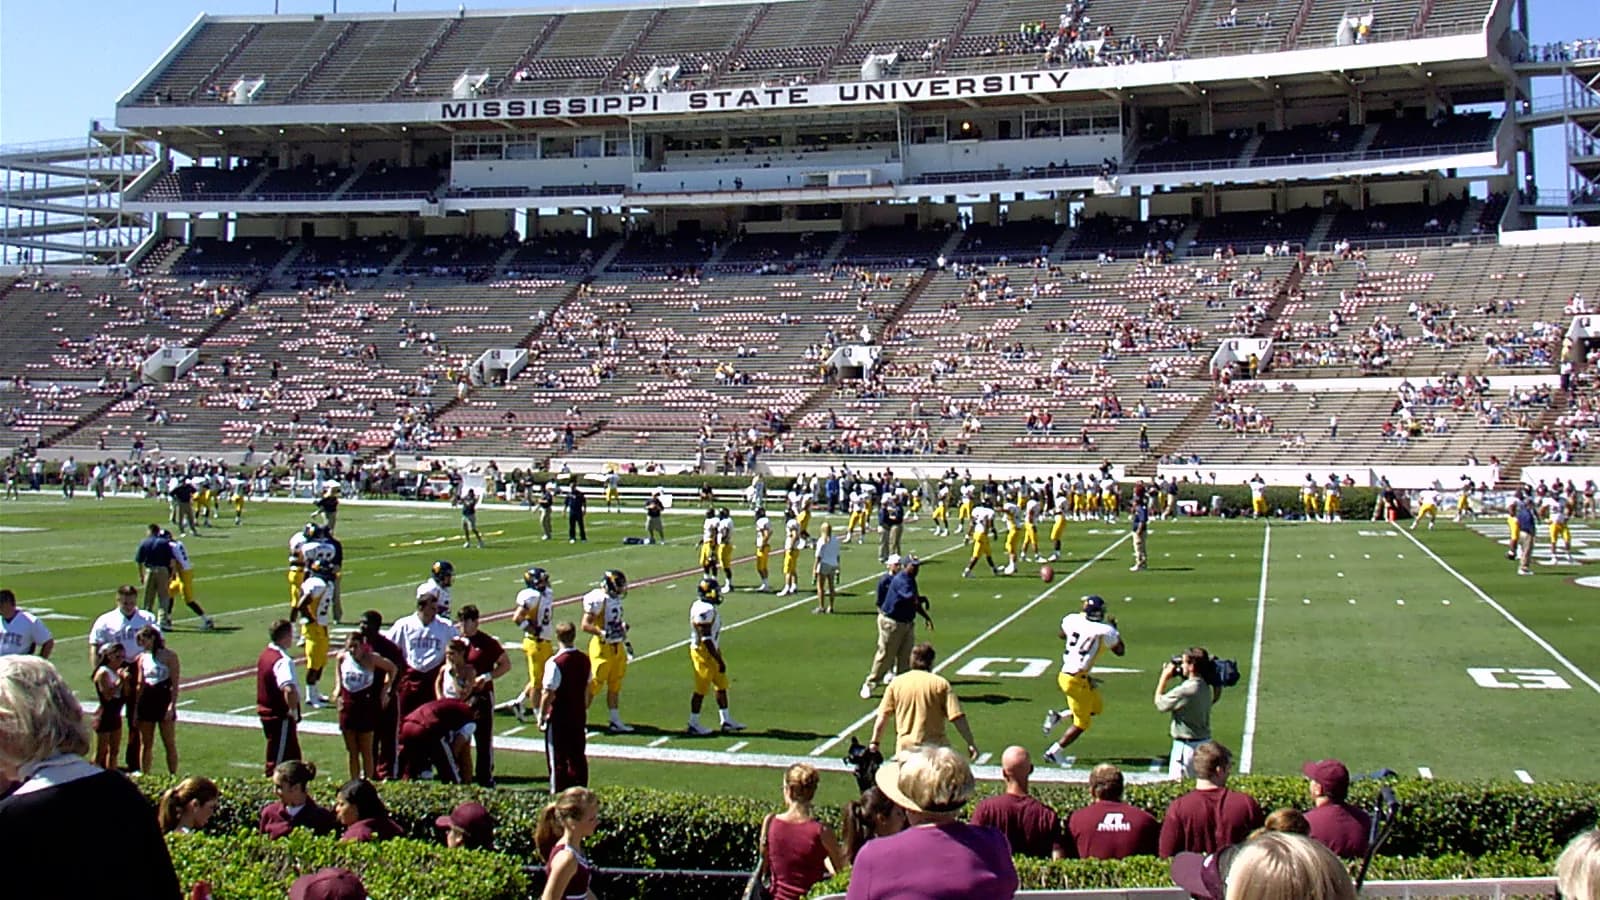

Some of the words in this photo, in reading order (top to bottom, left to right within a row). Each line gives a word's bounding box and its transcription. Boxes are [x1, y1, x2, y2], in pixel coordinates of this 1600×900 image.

[441, 95, 659, 119] MISSISSIPPI
[688, 88, 809, 110] STATE
[838, 71, 1070, 101] UNIVERSITY
[1063, 631, 1097, 662] 24
